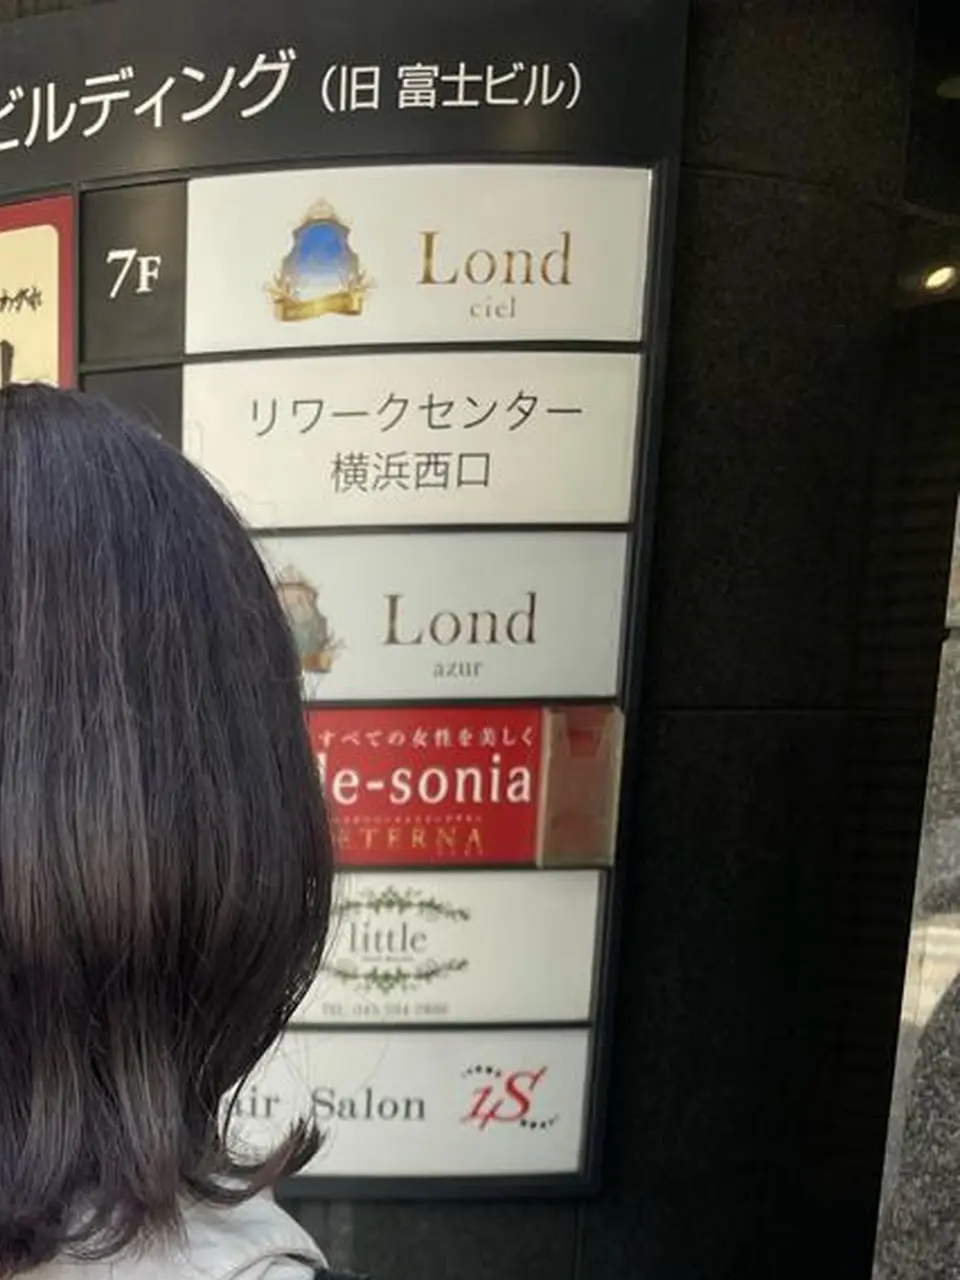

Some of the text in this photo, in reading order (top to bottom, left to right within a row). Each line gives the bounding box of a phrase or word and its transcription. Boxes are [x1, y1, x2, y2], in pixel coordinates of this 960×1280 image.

[106, 247, 162, 299] 7F
[417, 231, 573, 286] Lond
[469, 295, 517, 319] ciel
[249, 390, 584, 435] リワークセンター
[329, 450, 492, 493] 横浜西口
[383, 592, 538, 647] Lond
[432, 660, 483, 678] azur
[317, 726, 534, 749] すべての女性を美しく
[348, 921, 428, 954] little
[311, 1085, 426, 1122] Salon
